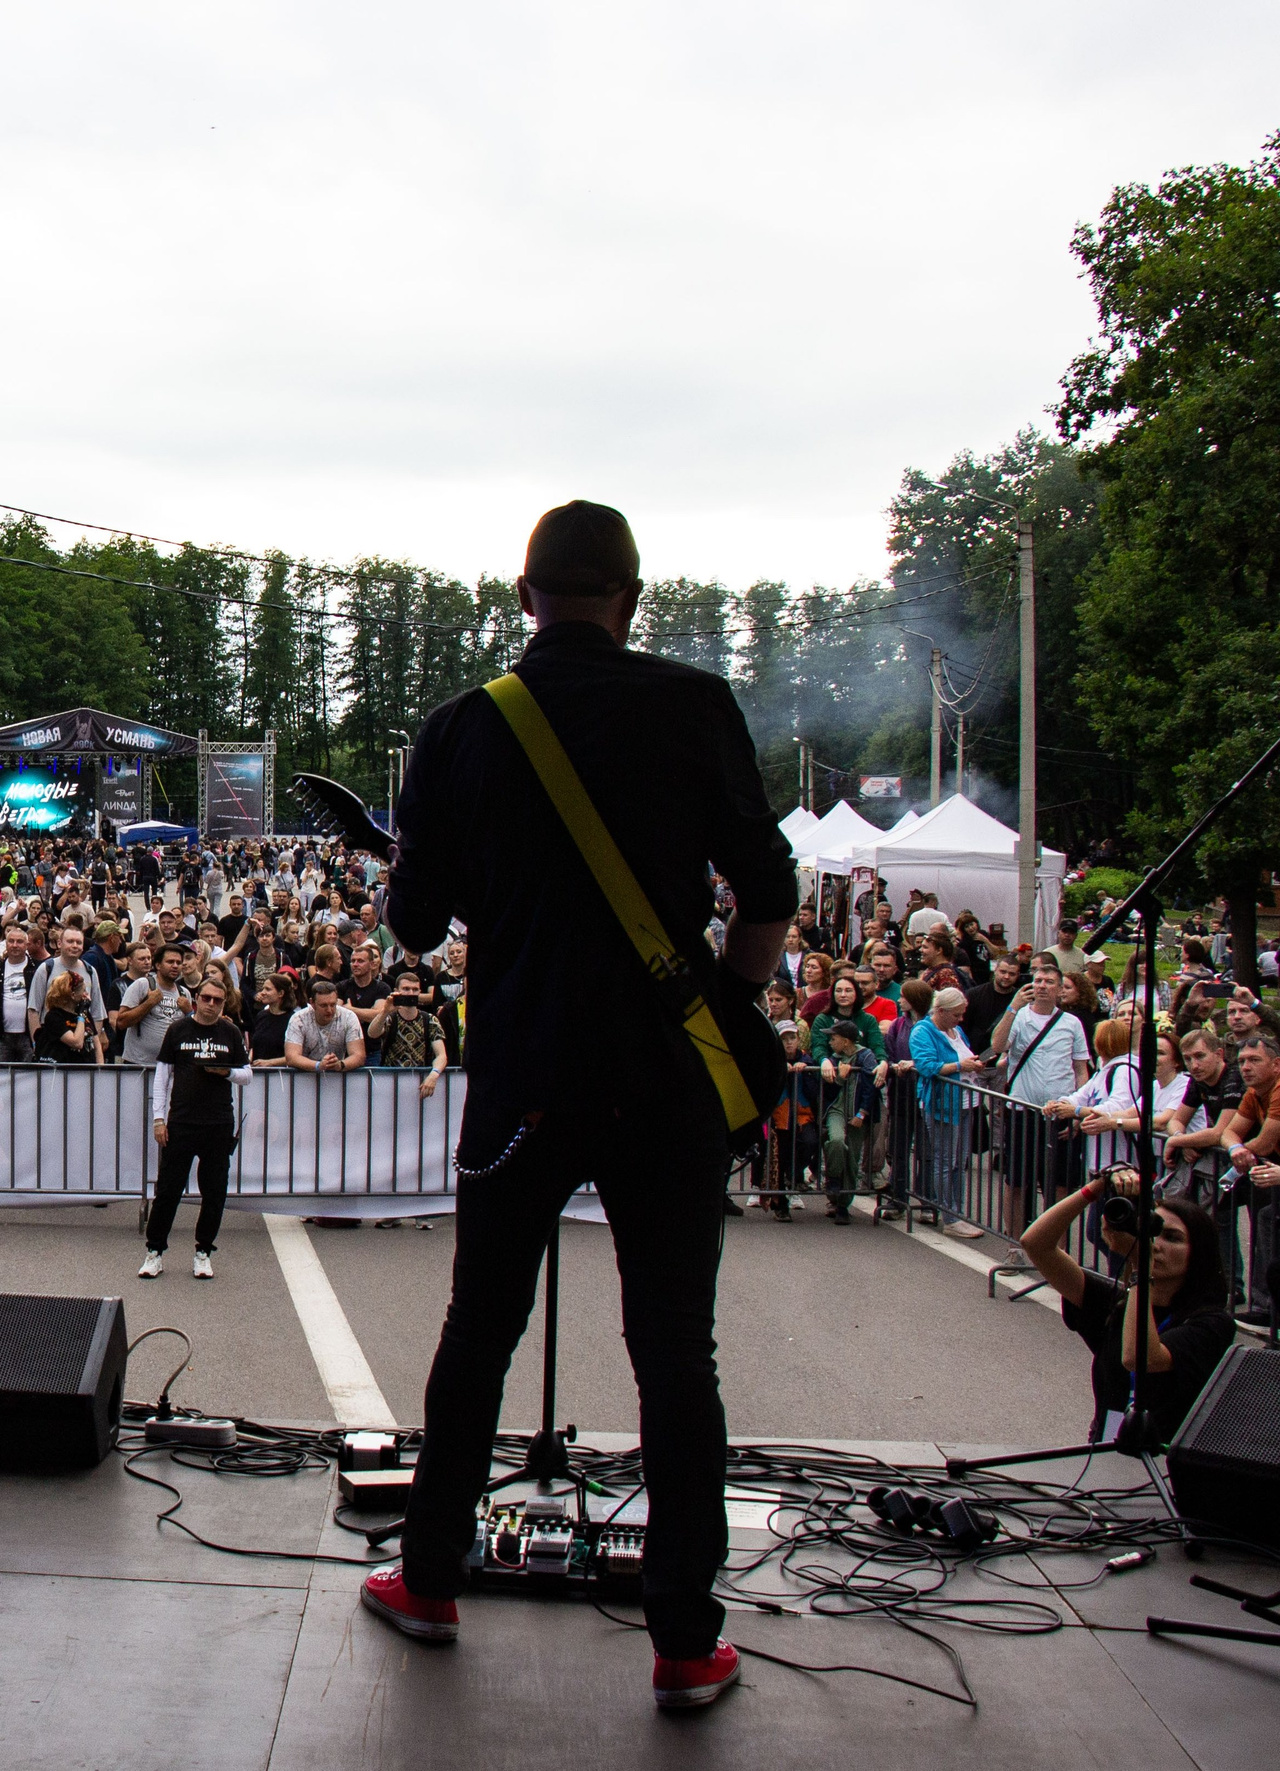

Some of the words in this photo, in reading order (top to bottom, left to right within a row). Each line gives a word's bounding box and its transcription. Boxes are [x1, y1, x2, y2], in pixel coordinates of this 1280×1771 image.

[22, 726, 61, 747] НОВАЯ
[105, 726, 155, 749] УСМАНЬ
[73, 739, 95, 749] ROCK
